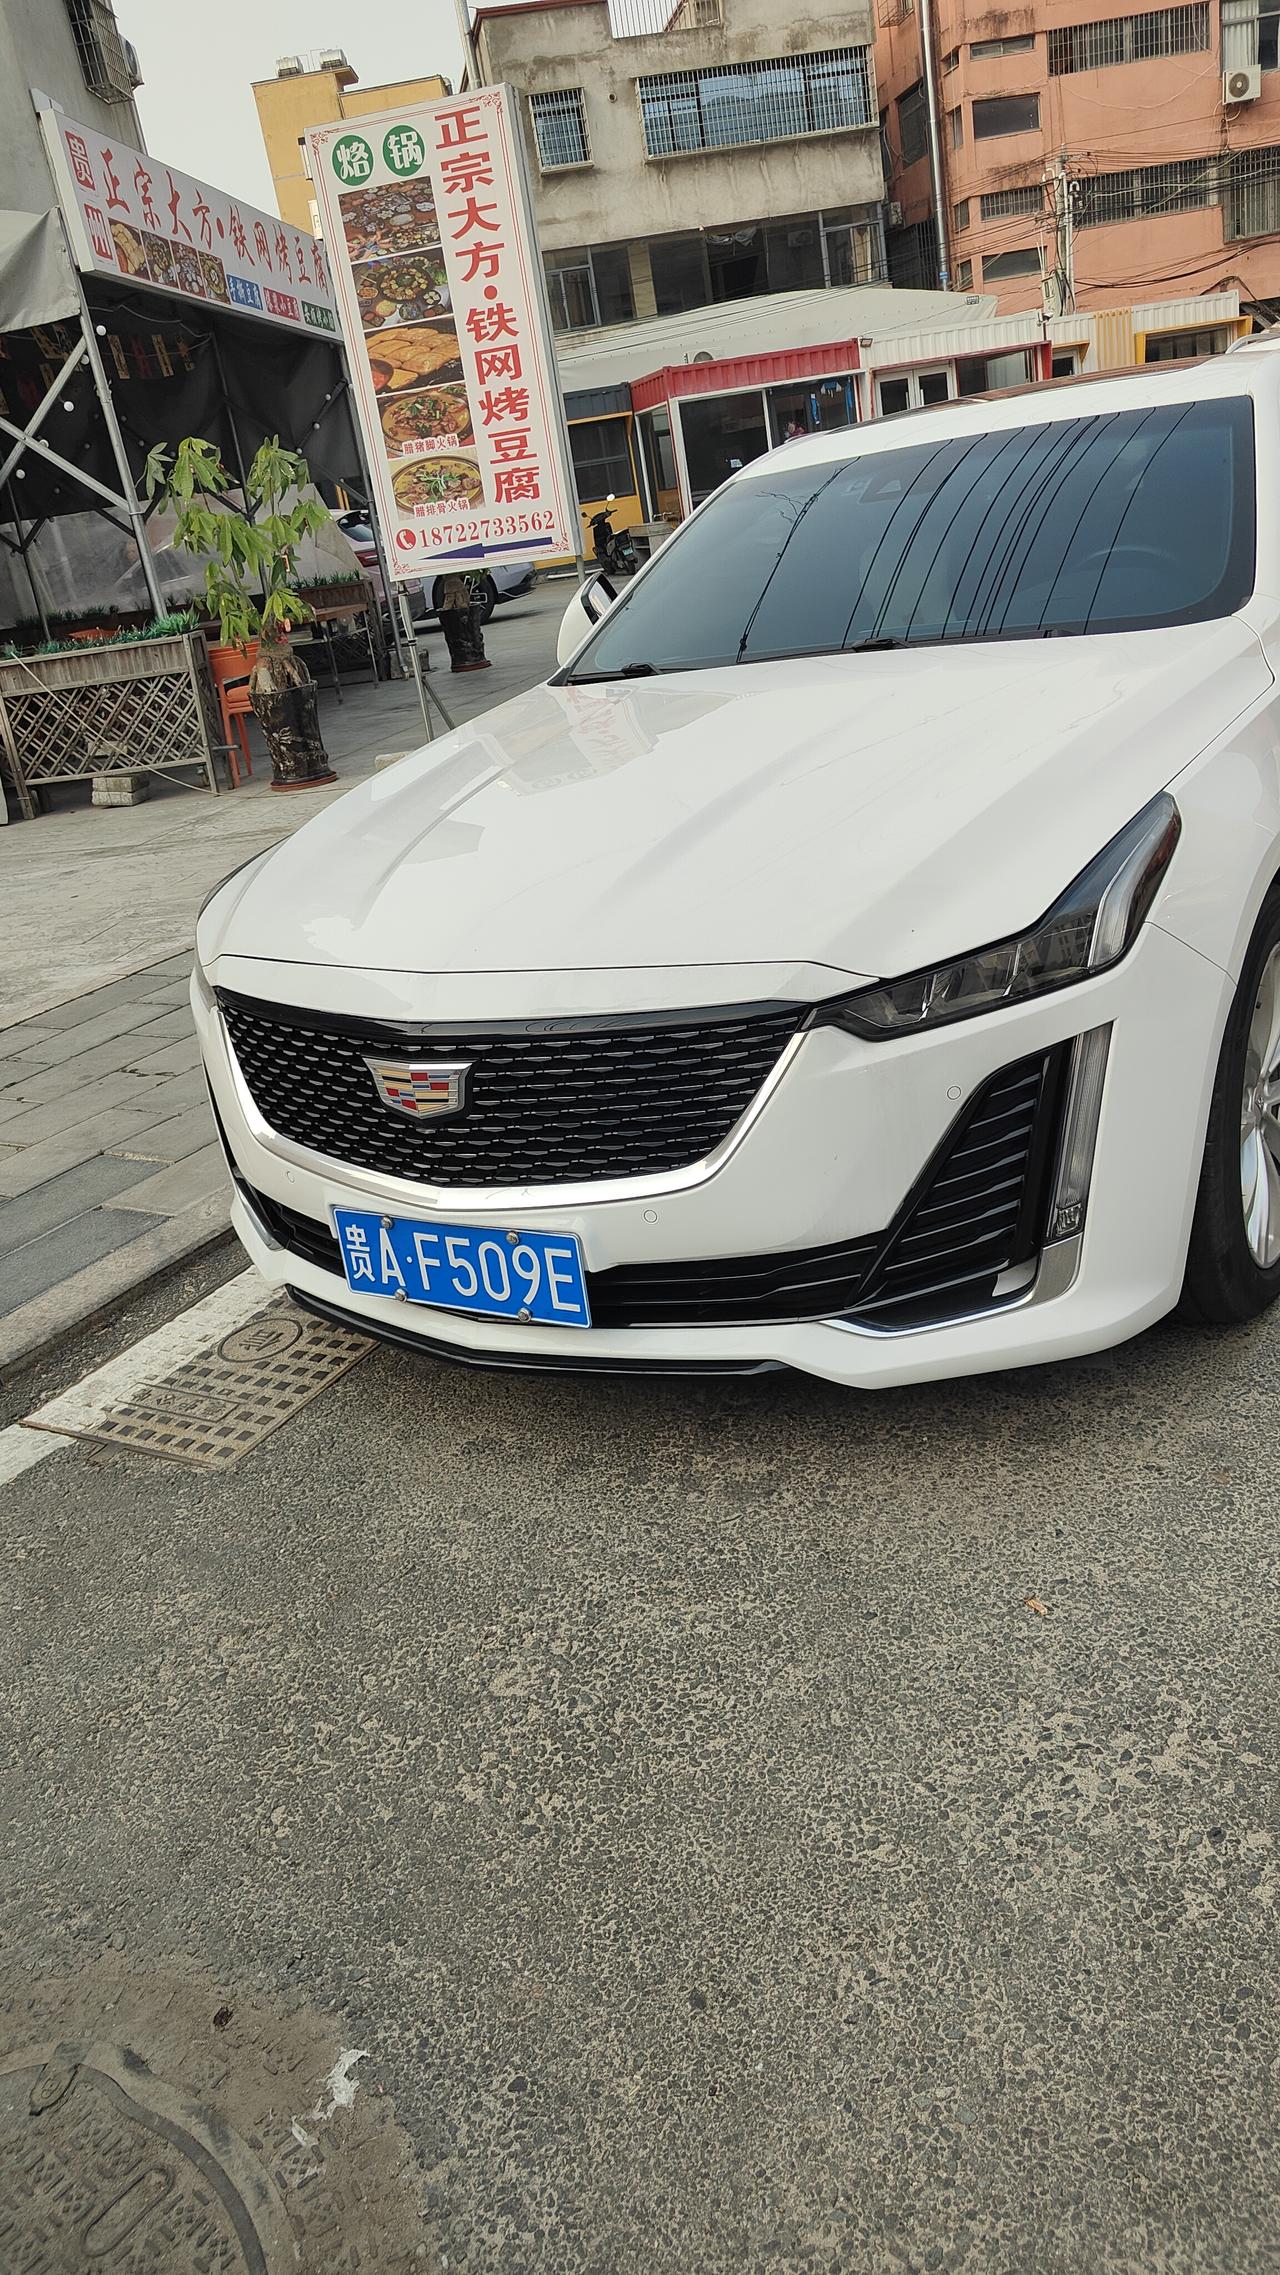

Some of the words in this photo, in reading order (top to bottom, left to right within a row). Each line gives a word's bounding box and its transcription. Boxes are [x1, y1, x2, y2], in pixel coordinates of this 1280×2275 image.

[336, 129, 423, 181] 烙锅
[403, 435, 458, 454] 腊猪脚火锅
[415, 499, 469, 518] 腊排骨火锅
[419, 510, 555, 548] 18722733562
